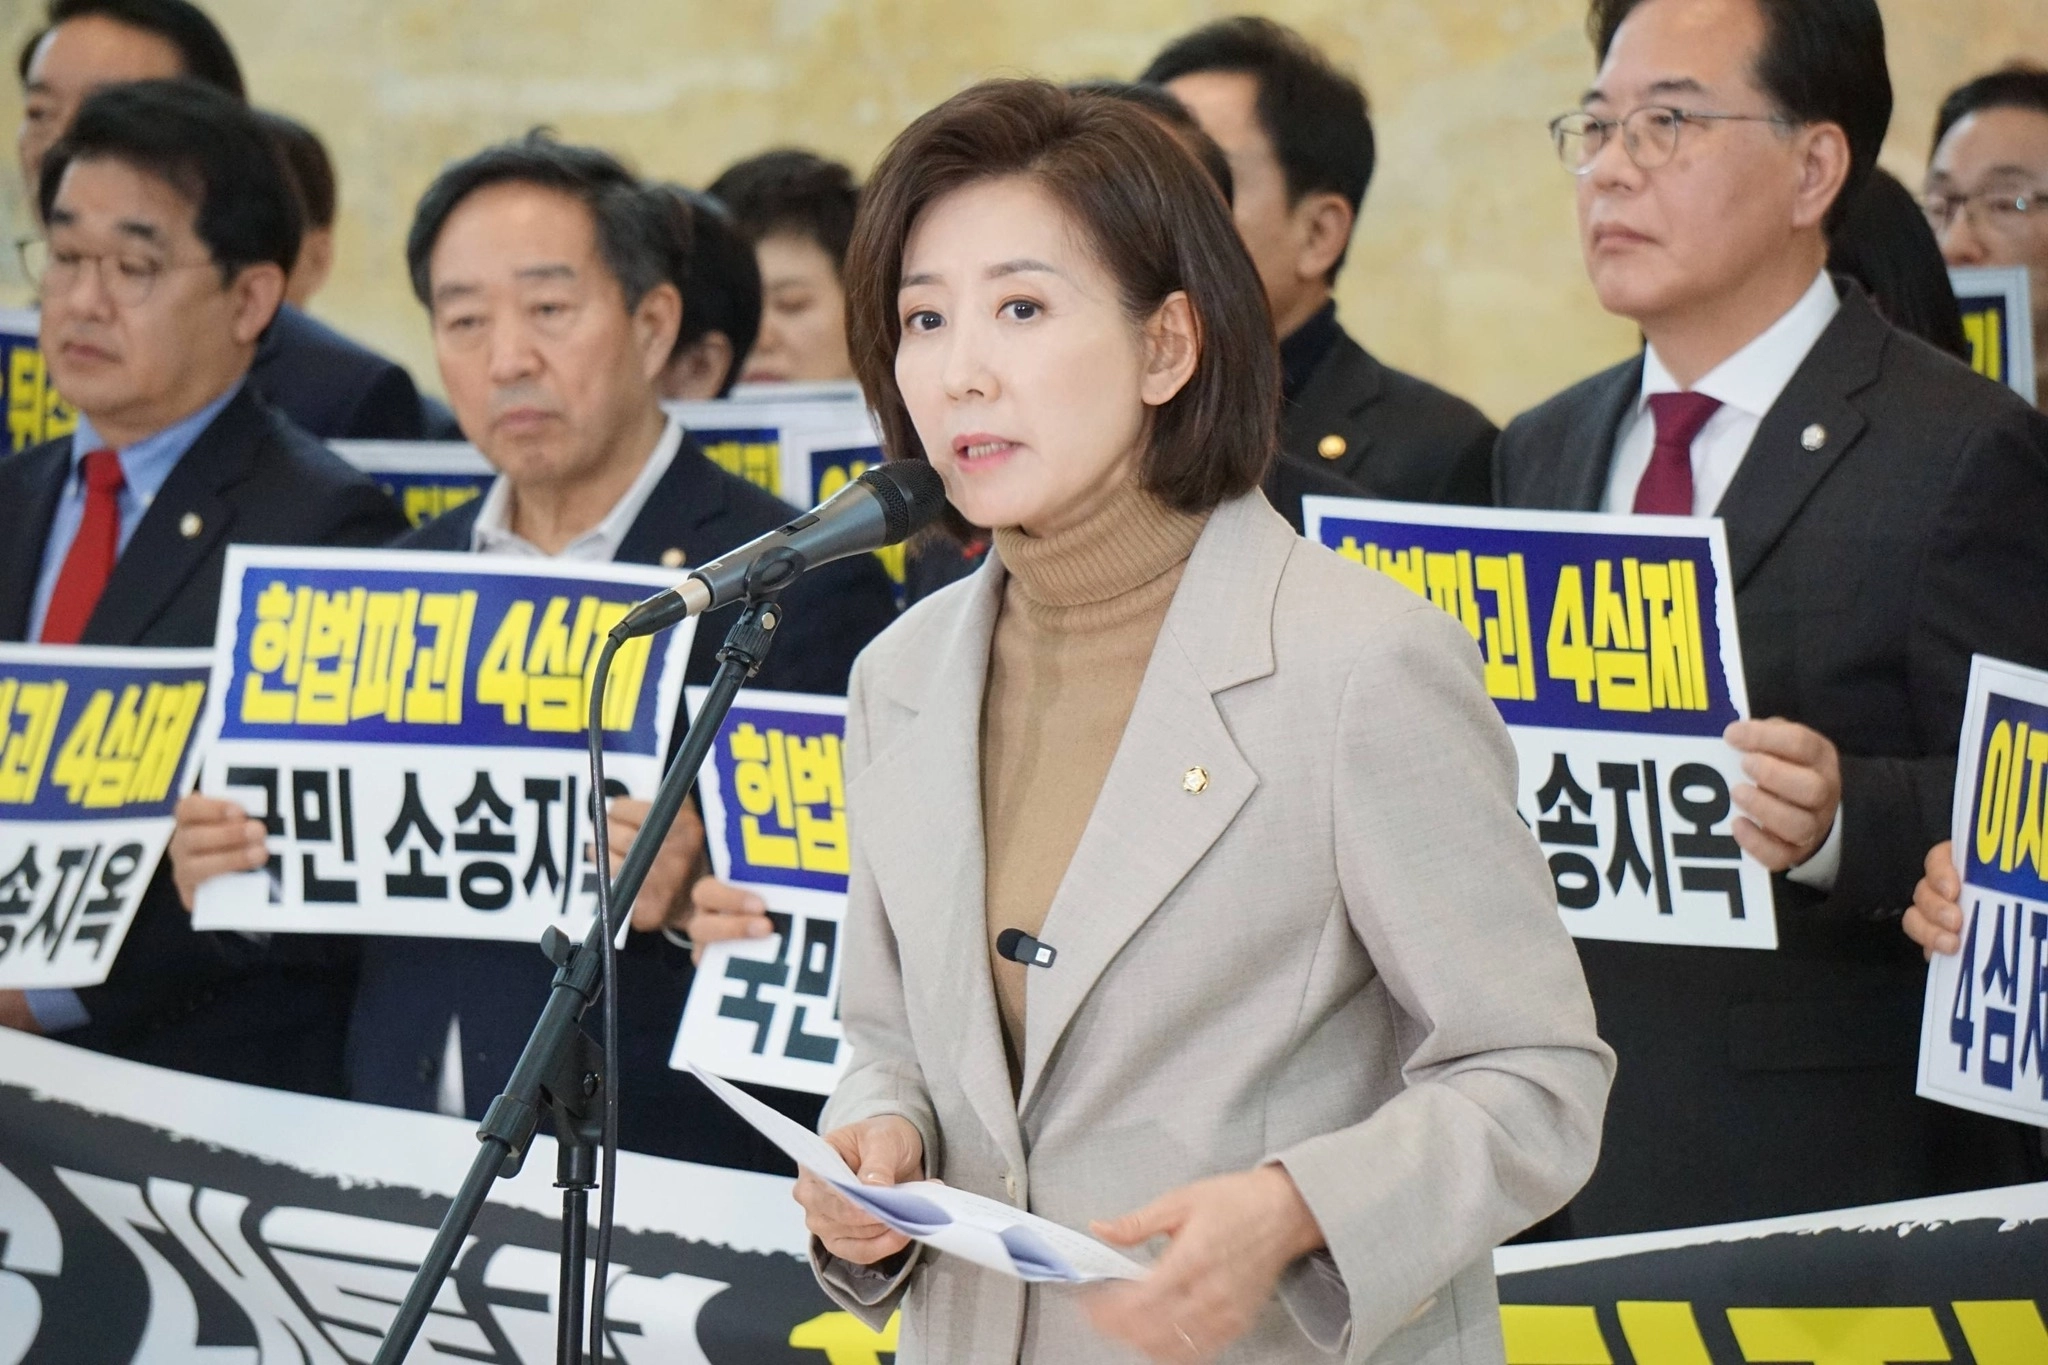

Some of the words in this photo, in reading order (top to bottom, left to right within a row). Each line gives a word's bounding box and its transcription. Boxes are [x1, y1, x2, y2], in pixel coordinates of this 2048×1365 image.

[241, 581, 478, 725] 헌법파괴
[476, 596, 655, 732] 4심제
[1546, 557, 1709, 713] 4심제
[0, 677, 68, 806] 괴
[52, 680, 205, 808] 4심제
[729, 722, 850, 876] 헌법
[225, 767, 359, 905] 국민
[1517, 752, 1746, 920] 송지옥
[717, 910, 843, 1066] 국민
